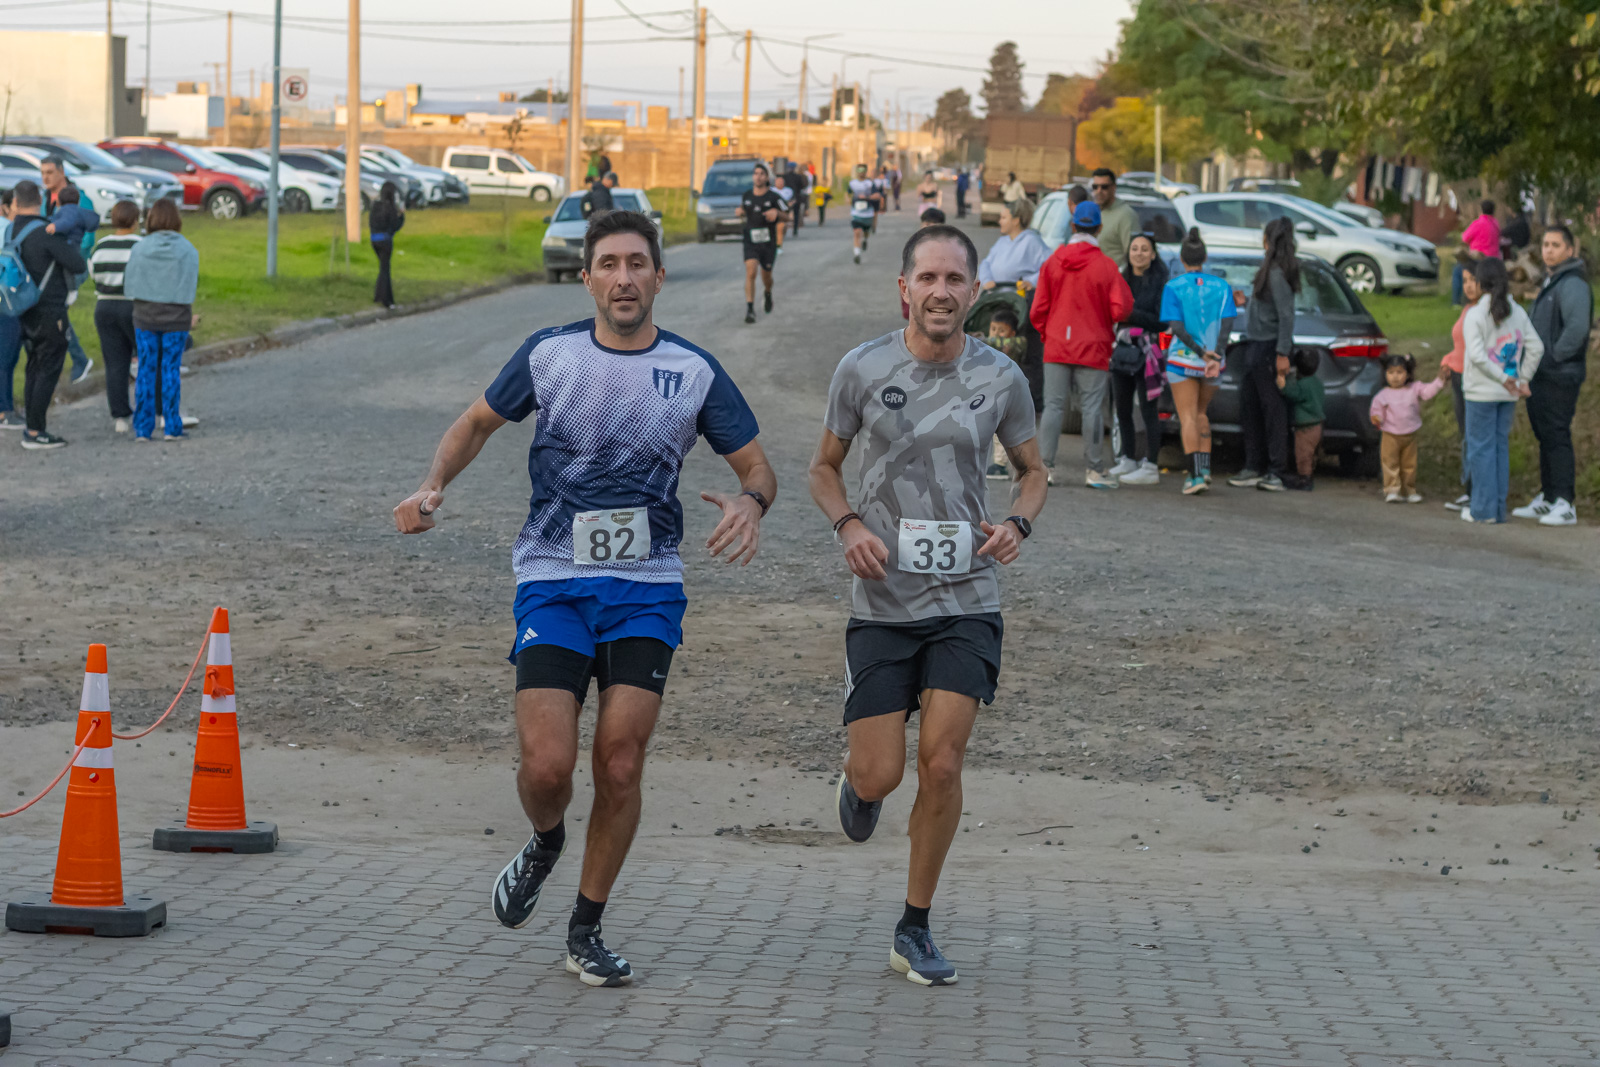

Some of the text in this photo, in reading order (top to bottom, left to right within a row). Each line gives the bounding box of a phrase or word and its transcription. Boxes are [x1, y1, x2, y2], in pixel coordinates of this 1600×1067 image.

[289, 81, 301, 96] E
[658, 371, 678, 381] SFC
[884, 392, 904, 404] CRR
[589, 527, 636, 562] 82
[912, 538, 957, 571] 33
